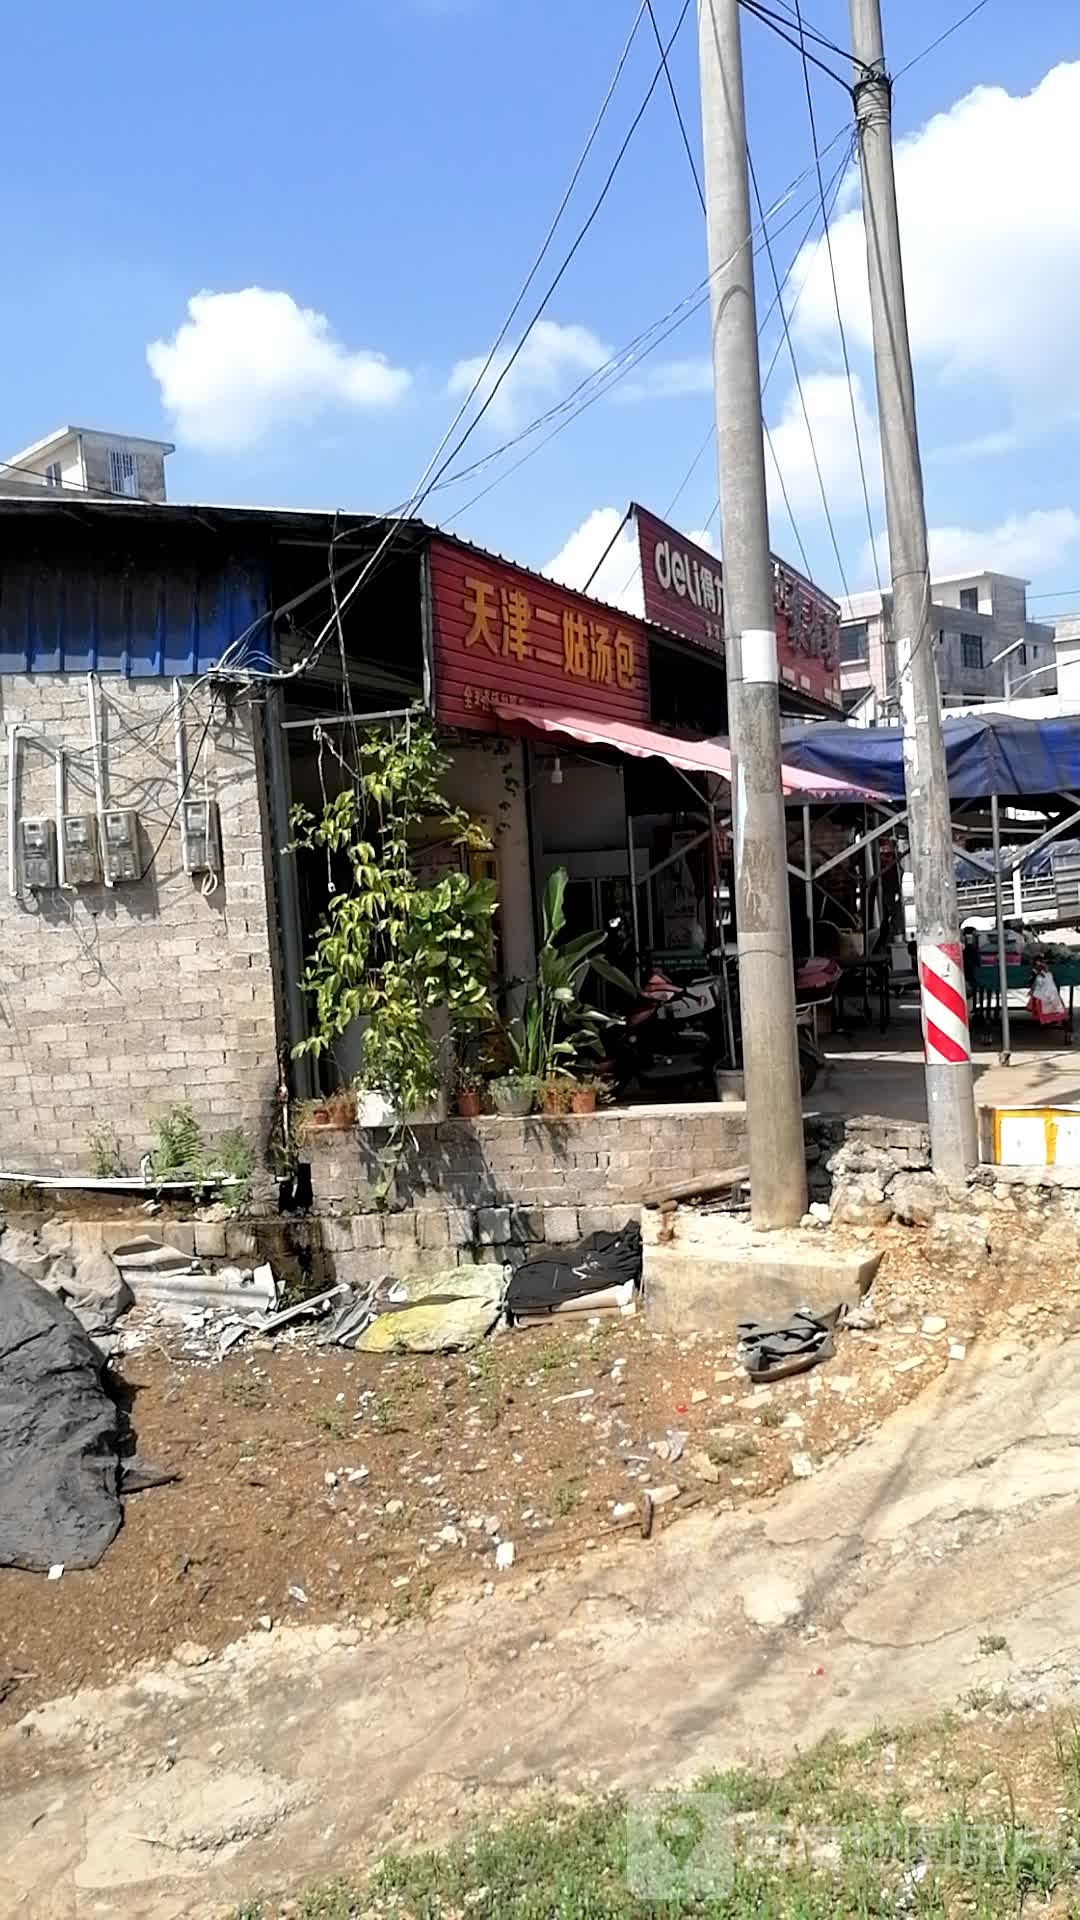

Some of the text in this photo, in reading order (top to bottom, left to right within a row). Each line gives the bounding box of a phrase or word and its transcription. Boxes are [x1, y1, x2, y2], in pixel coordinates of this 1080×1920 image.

[464, 576, 636, 690] 天津二姑汤包
